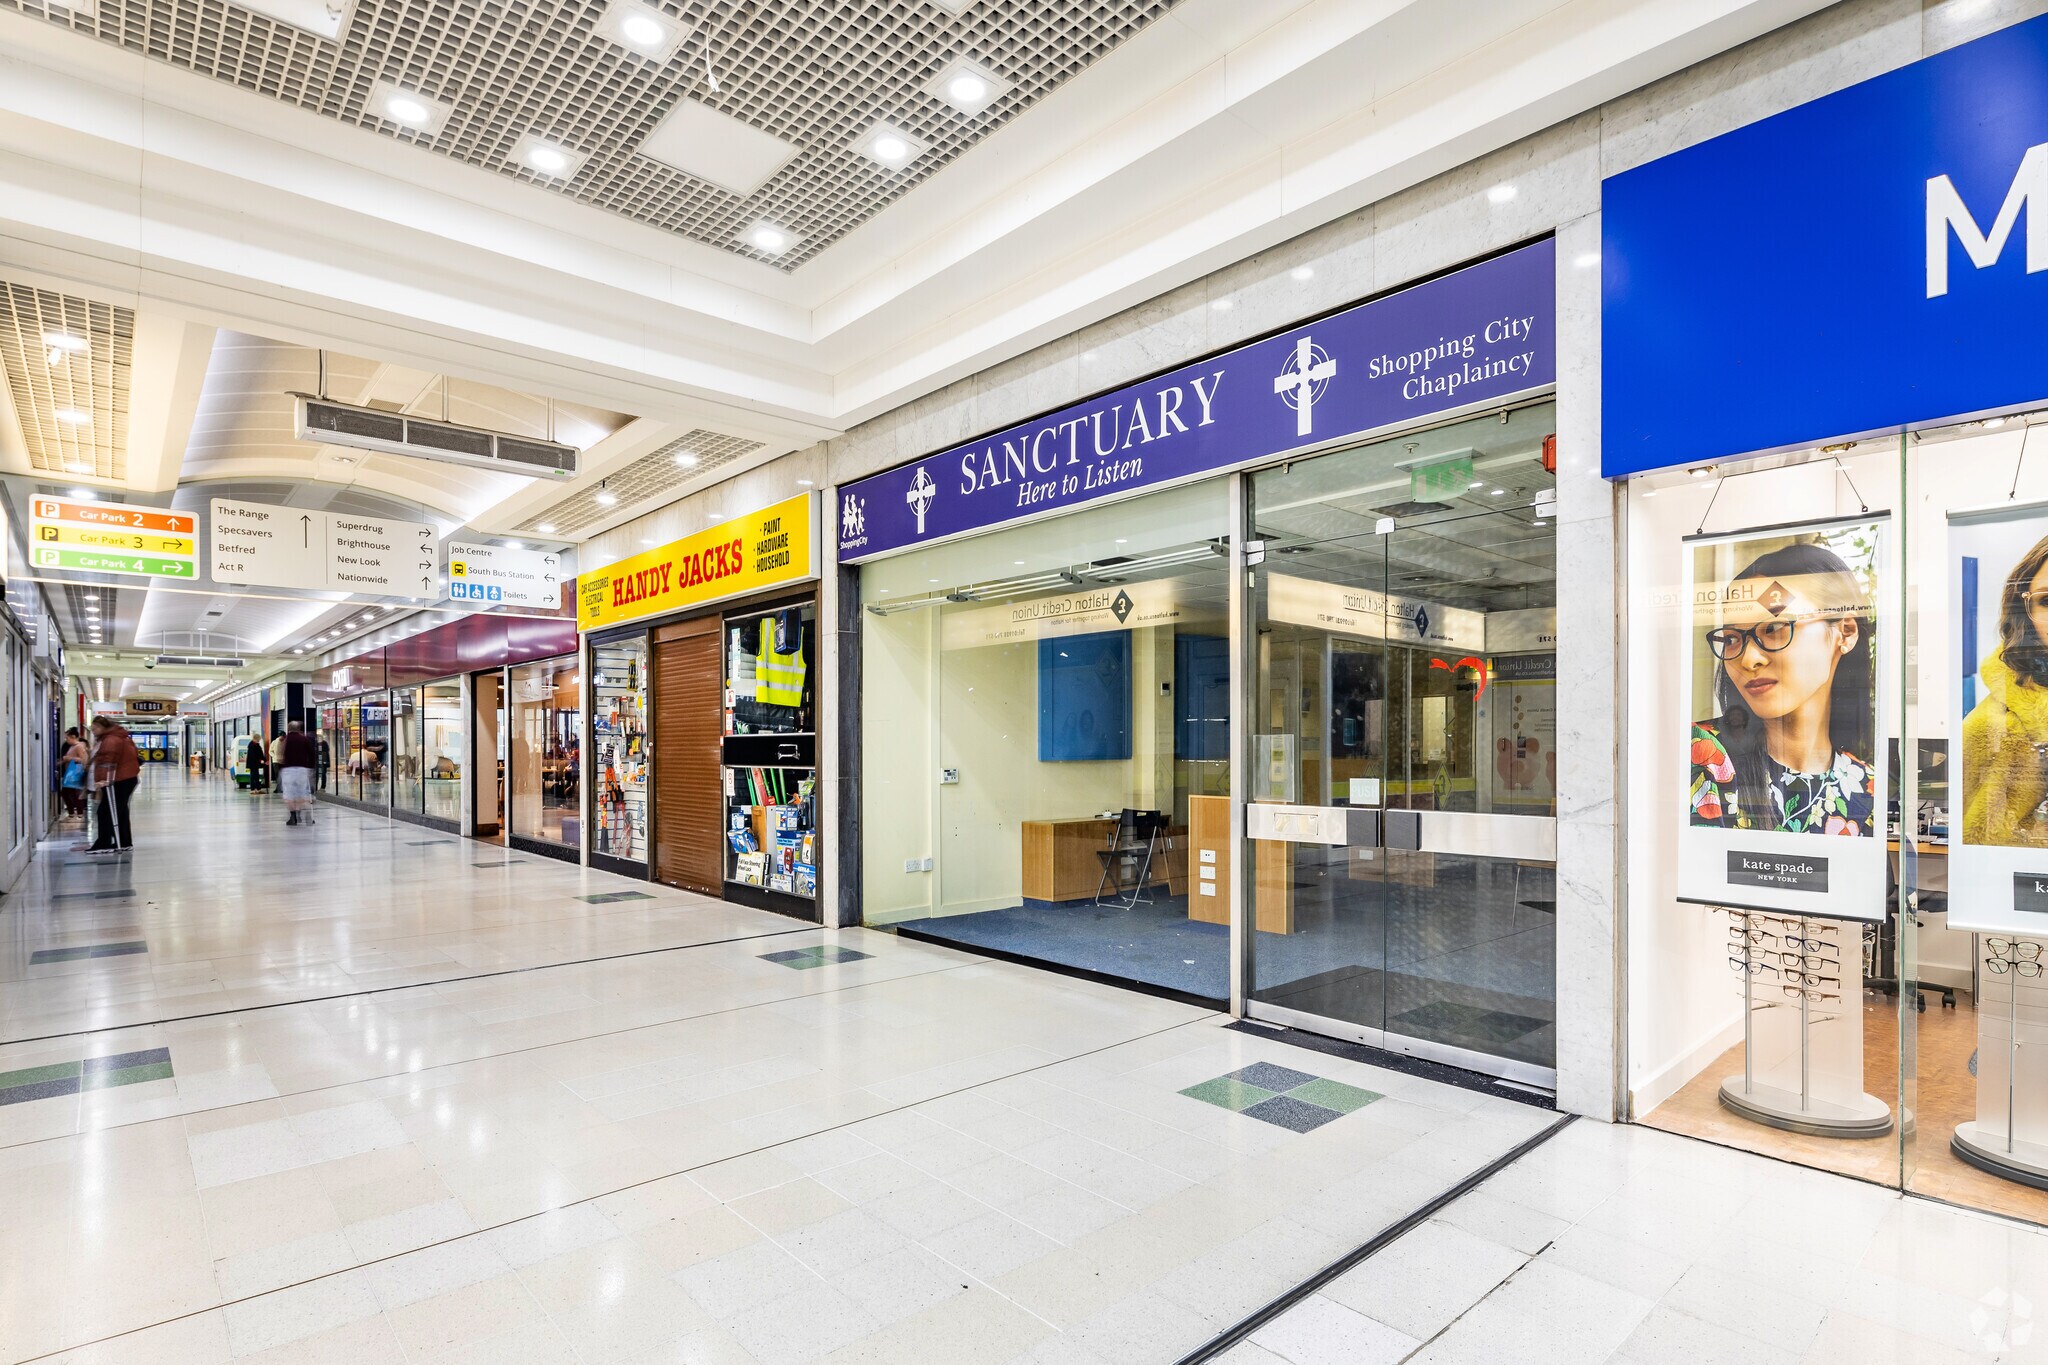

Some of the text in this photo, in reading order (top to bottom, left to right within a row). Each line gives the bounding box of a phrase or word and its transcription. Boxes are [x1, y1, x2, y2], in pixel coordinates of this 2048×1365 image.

[1368, 315, 1535, 380] Shopping City
[1402, 350, 1535, 400] Chaplaincy
[960, 370, 1225, 495] SANCTUARY
[1016, 457, 1143, 508] Here to Listen
[79, 510, 98, 520] Car
[101, 511, 126, 523] Park
[132, 513, 144, 527] 2
[218, 506, 269, 521] The Range
[218, 524, 273, 538] Specsavers
[336, 520, 384, 535] Superdrug
[763, 517, 781, 536] PAINT
[79, 533, 98, 543] Car
[101, 535, 126, 546] Park
[133, 536, 143, 549] 3
[337, 538, 391, 552] Brighthouse
[756, 532, 789, 555] HARDWARE
[840, 535, 868, 550] ShoppingCity
[218, 543, 256, 555] Betfred
[451, 546, 493, 558] Job Centre
[79, 557, 98, 567] Car
[101, 558, 126, 569] Park
[132, 559, 144, 572] 4
[218, 562, 245, 572] Act R
[337, 555, 381, 567] New Look
[756, 550, 790, 573] HOUSEHOLD
[337, 572, 388, 585] Nationwide
[468, 566, 535, 580] South Bus Station
[613, 538, 743, 607] HANDY JACKS
[588, 576, 609, 592] ACCESSORIES
[502, 590, 528, 601] Toilets
[585, 593, 604, 607] ELECTRICAL
[589, 607, 600, 618] TOOLS
[135, 702, 147, 710] THE
[1742, 858, 1814, 876] kate spade
[1757, 874, 1798, 884] NEW YORK
